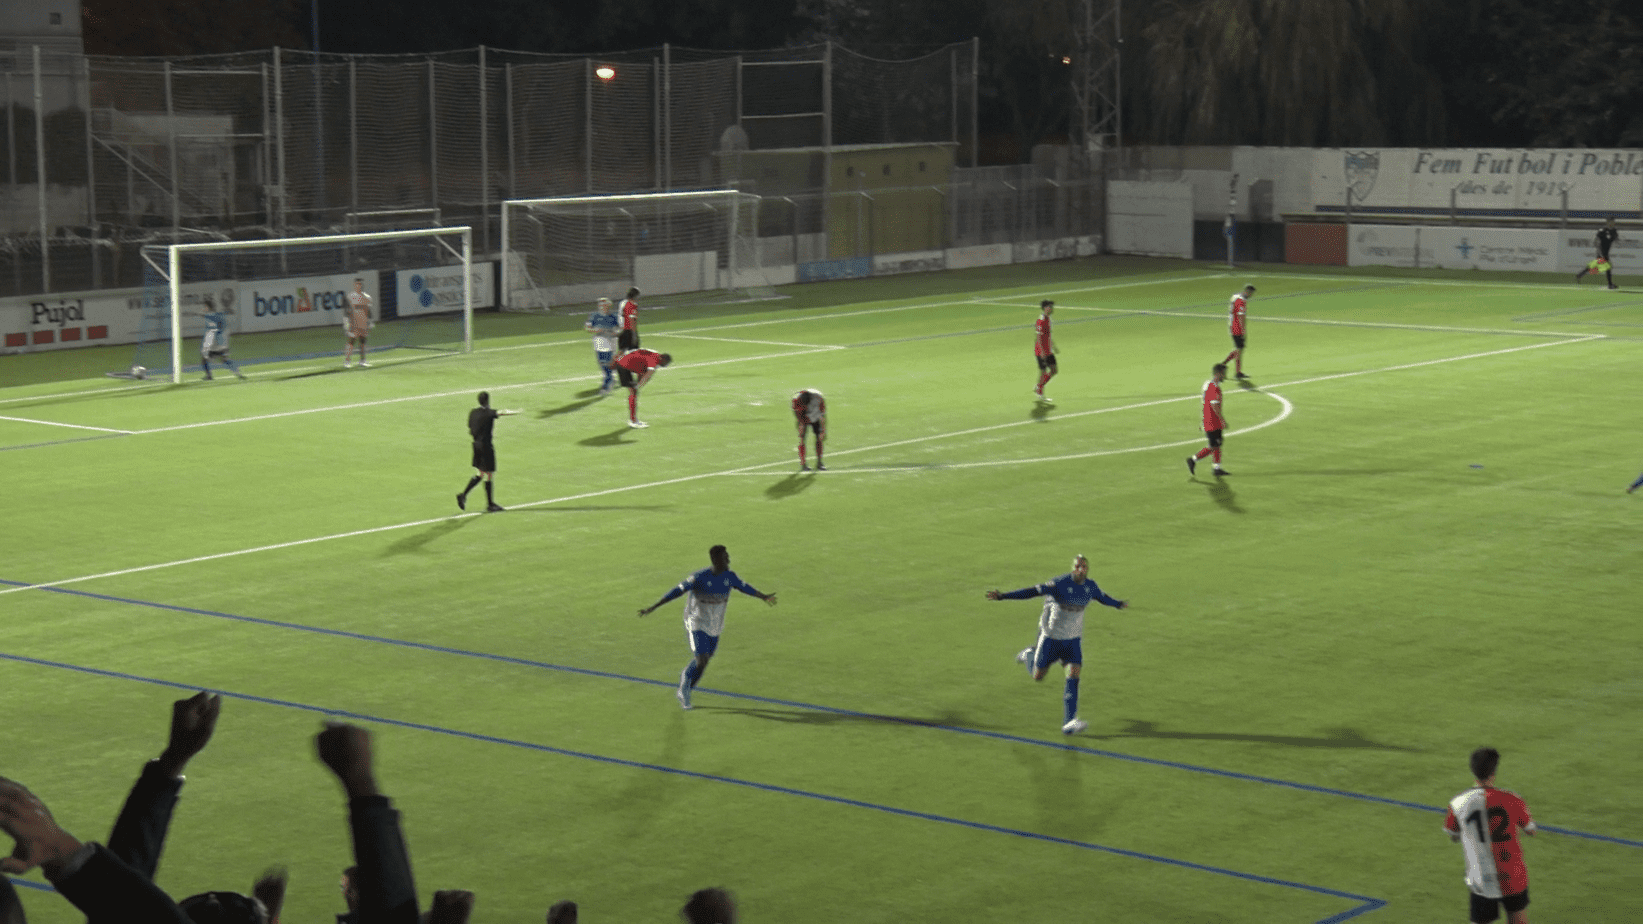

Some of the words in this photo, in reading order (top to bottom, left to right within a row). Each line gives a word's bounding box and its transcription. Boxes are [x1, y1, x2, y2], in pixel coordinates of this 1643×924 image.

[1412, 152, 1463, 174] Fem
[1562, 153, 1573, 174] i
[1491, 180, 1513, 195] de
[31, 299, 85, 327] Pujol
[253, 286, 347, 317] bonArea
[1466, 806, 1512, 843] 12
